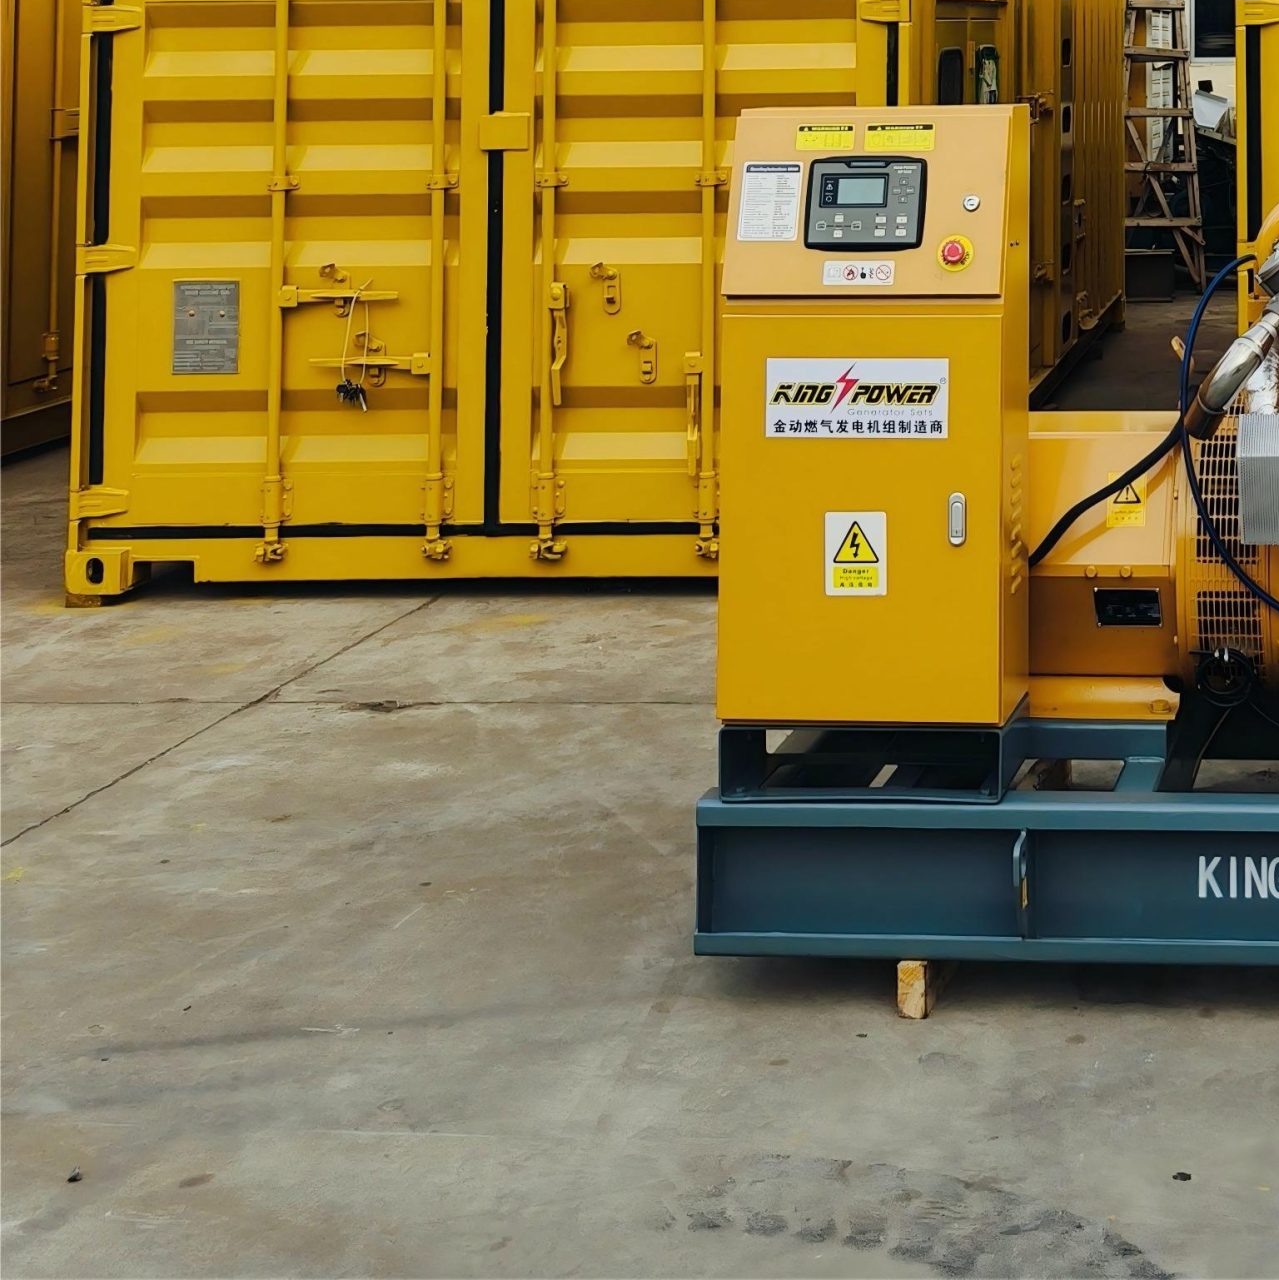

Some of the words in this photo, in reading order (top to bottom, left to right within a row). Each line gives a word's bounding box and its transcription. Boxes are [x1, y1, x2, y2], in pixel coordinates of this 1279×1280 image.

[770, 383, 836, 405] KING
[848, 383, 941, 405] POWER
[773, 419, 943, 434] 金动燃气发电机组制造商
